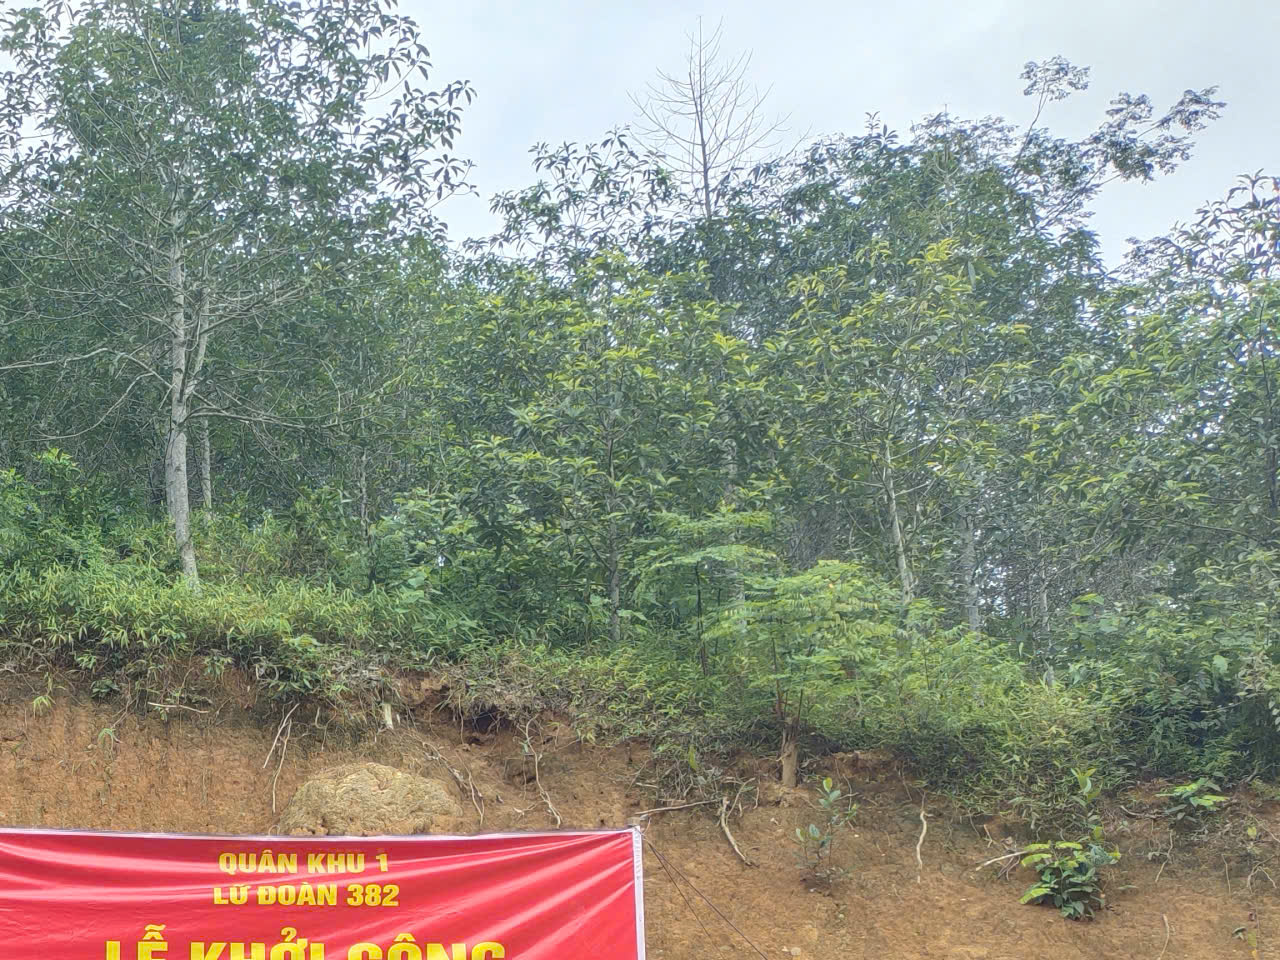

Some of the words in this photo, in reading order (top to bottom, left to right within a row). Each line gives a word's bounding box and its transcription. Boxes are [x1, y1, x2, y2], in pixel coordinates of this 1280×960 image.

[219, 850, 298, 875] QUÂN
[307, 853, 365, 873] KHU
[375, 853, 389, 872] 1
[257, 882, 338, 905] ĐOÀN
[346, 884, 400, 906] 382
